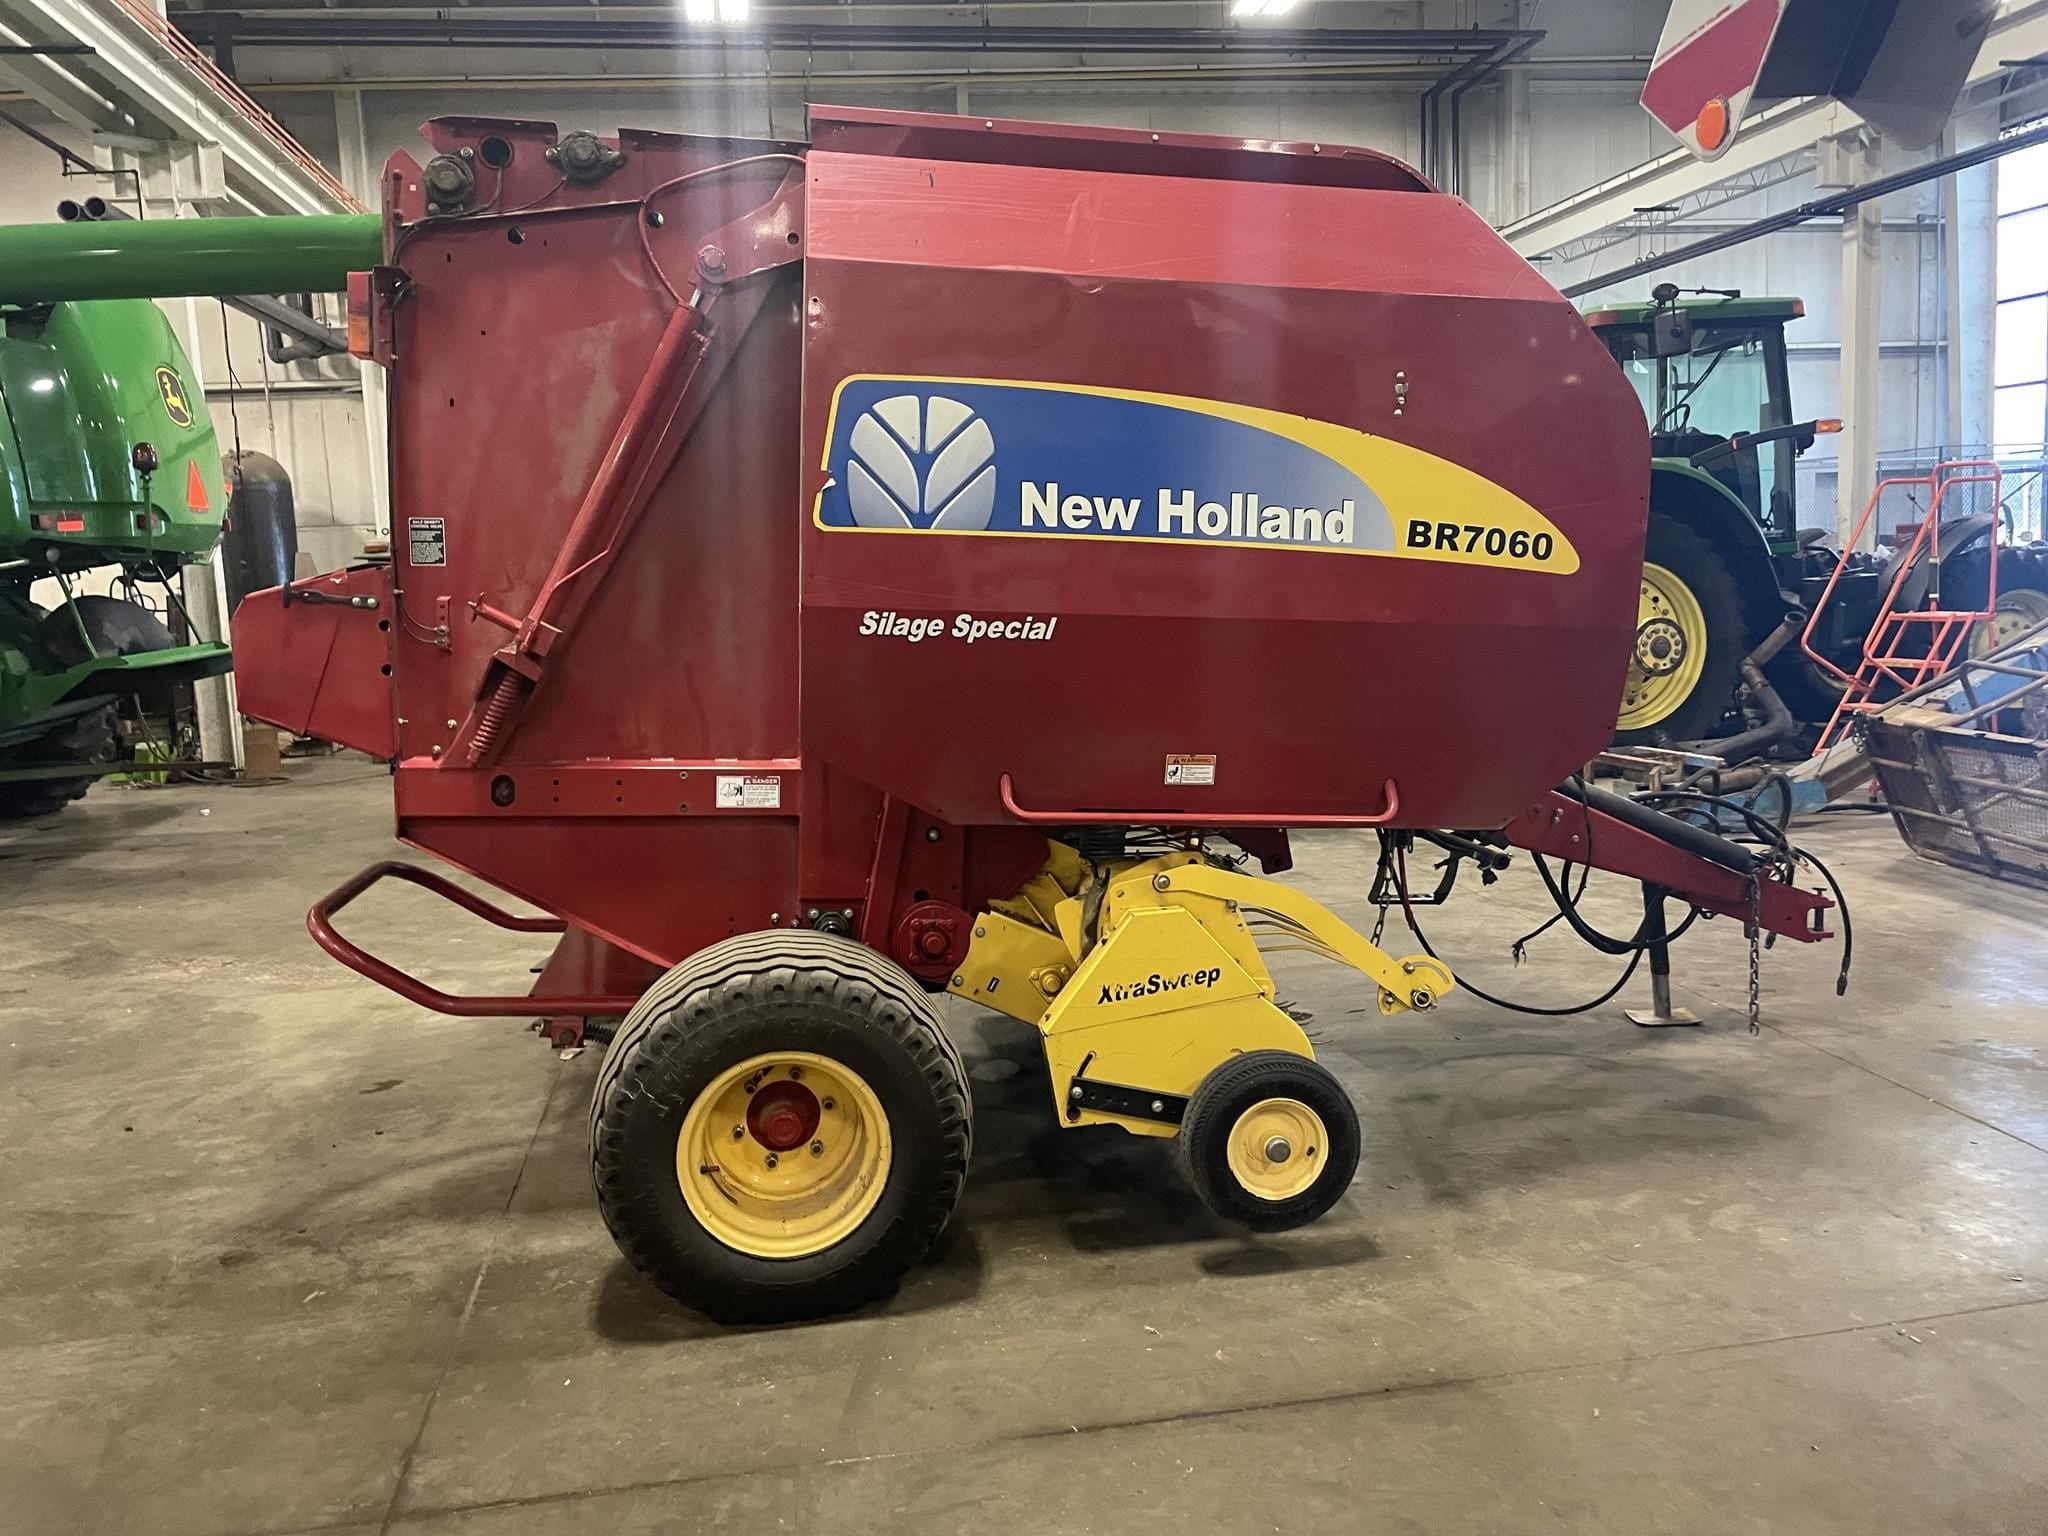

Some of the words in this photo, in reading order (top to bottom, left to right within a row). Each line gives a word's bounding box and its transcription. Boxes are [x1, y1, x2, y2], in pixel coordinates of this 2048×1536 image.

[1021, 481, 1141, 531] New
[1158, 489, 1355, 543] Holland
[1407, 520, 1553, 560] BR7060
[859, 611, 944, 642] Silage
[951, 614, 1057, 643] Special
